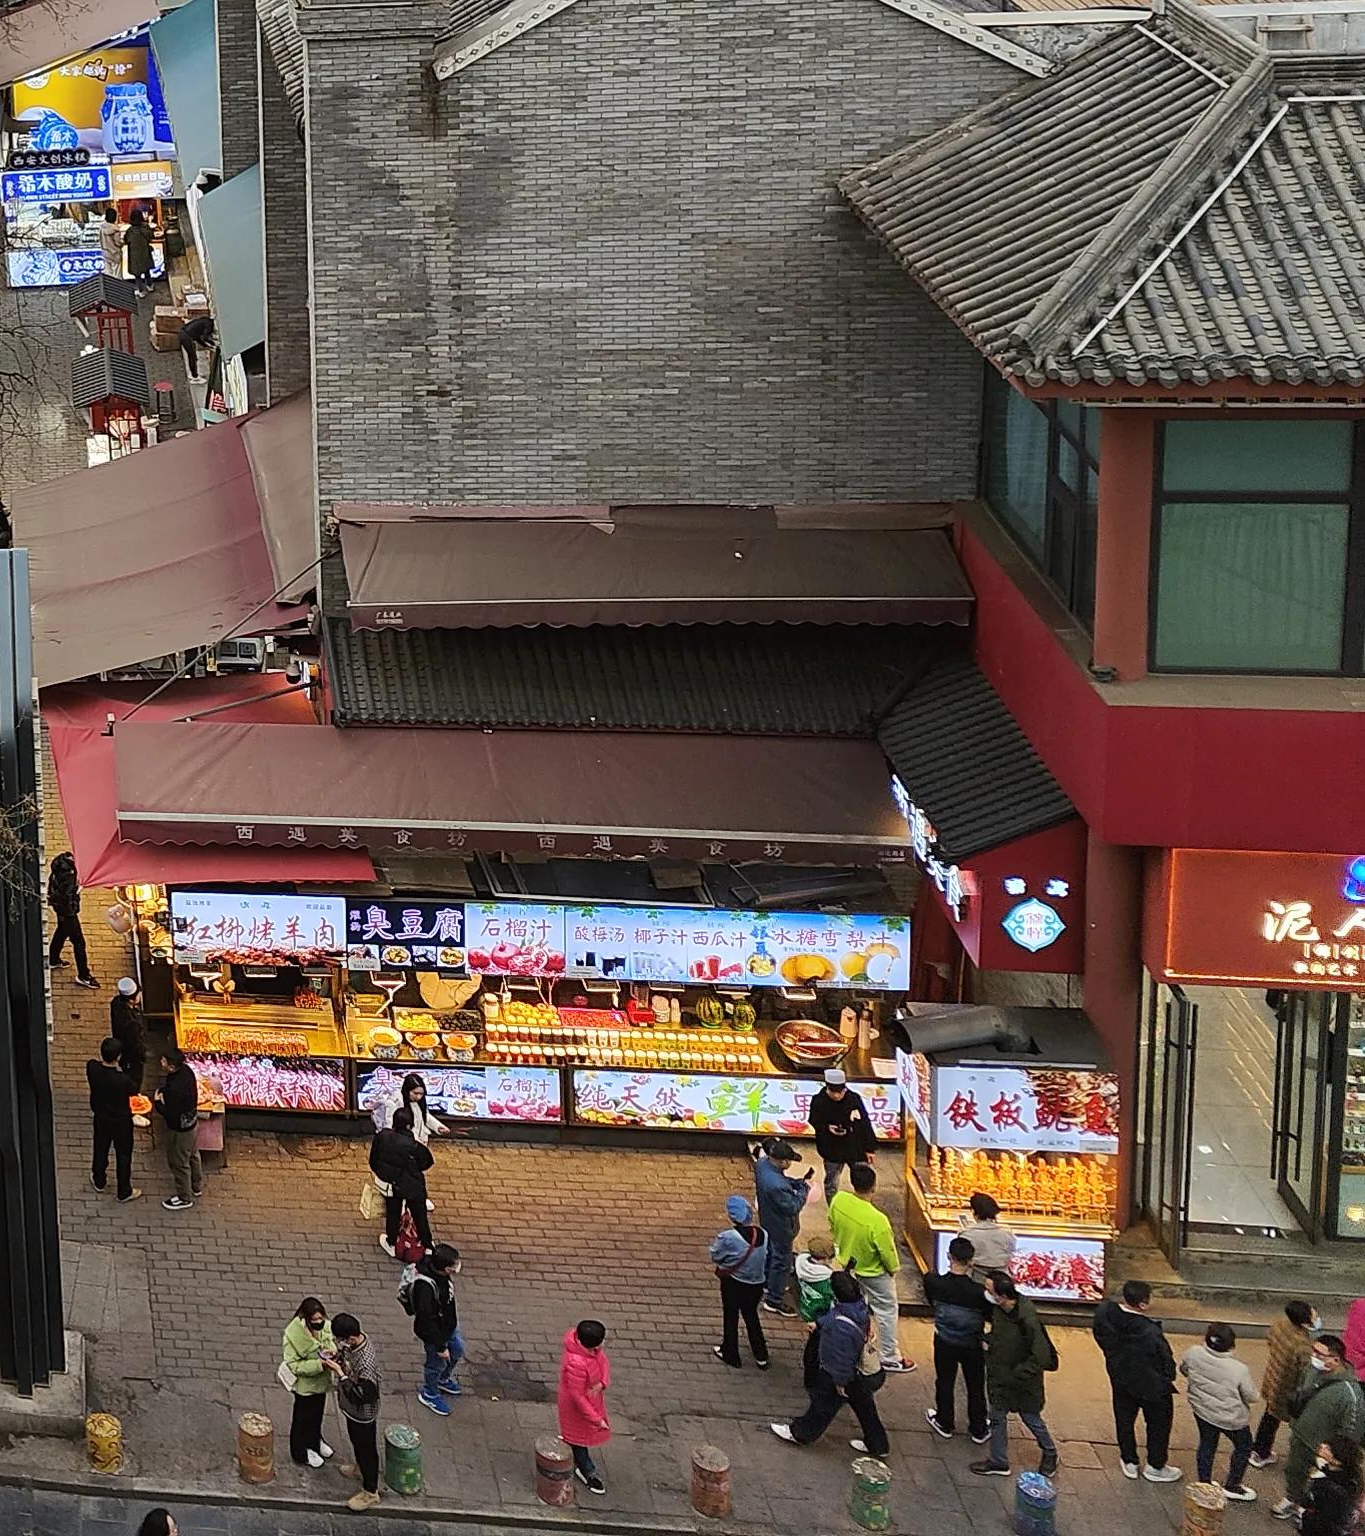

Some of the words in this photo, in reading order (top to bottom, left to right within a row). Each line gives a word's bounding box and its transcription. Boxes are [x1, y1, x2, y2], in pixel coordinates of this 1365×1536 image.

[235, 825, 467, 847] 西遇美食坊
[537, 834, 785, 857] 西遇美食坊
[185, 915, 338, 951] 红柳烤羊肉
[363, 905, 463, 942] 臭豆腐
[481, 918, 553, 940] 石榴汁
[574, 926, 626, 944] 酸梅汤
[634, 927, 688, 946] 椰子汁
[692, 930, 748, 948] 西瓜汁
[773, 928, 892, 949] 冰糖雪梨汁
[221, 1073, 336, 1109] 柳烤羊肉
[372, 1068, 463, 1098] 臭腐
[498, 1077, 551, 1099] 石榴汁
[944, 1090, 1119, 1139] 铁板鱿鱼
